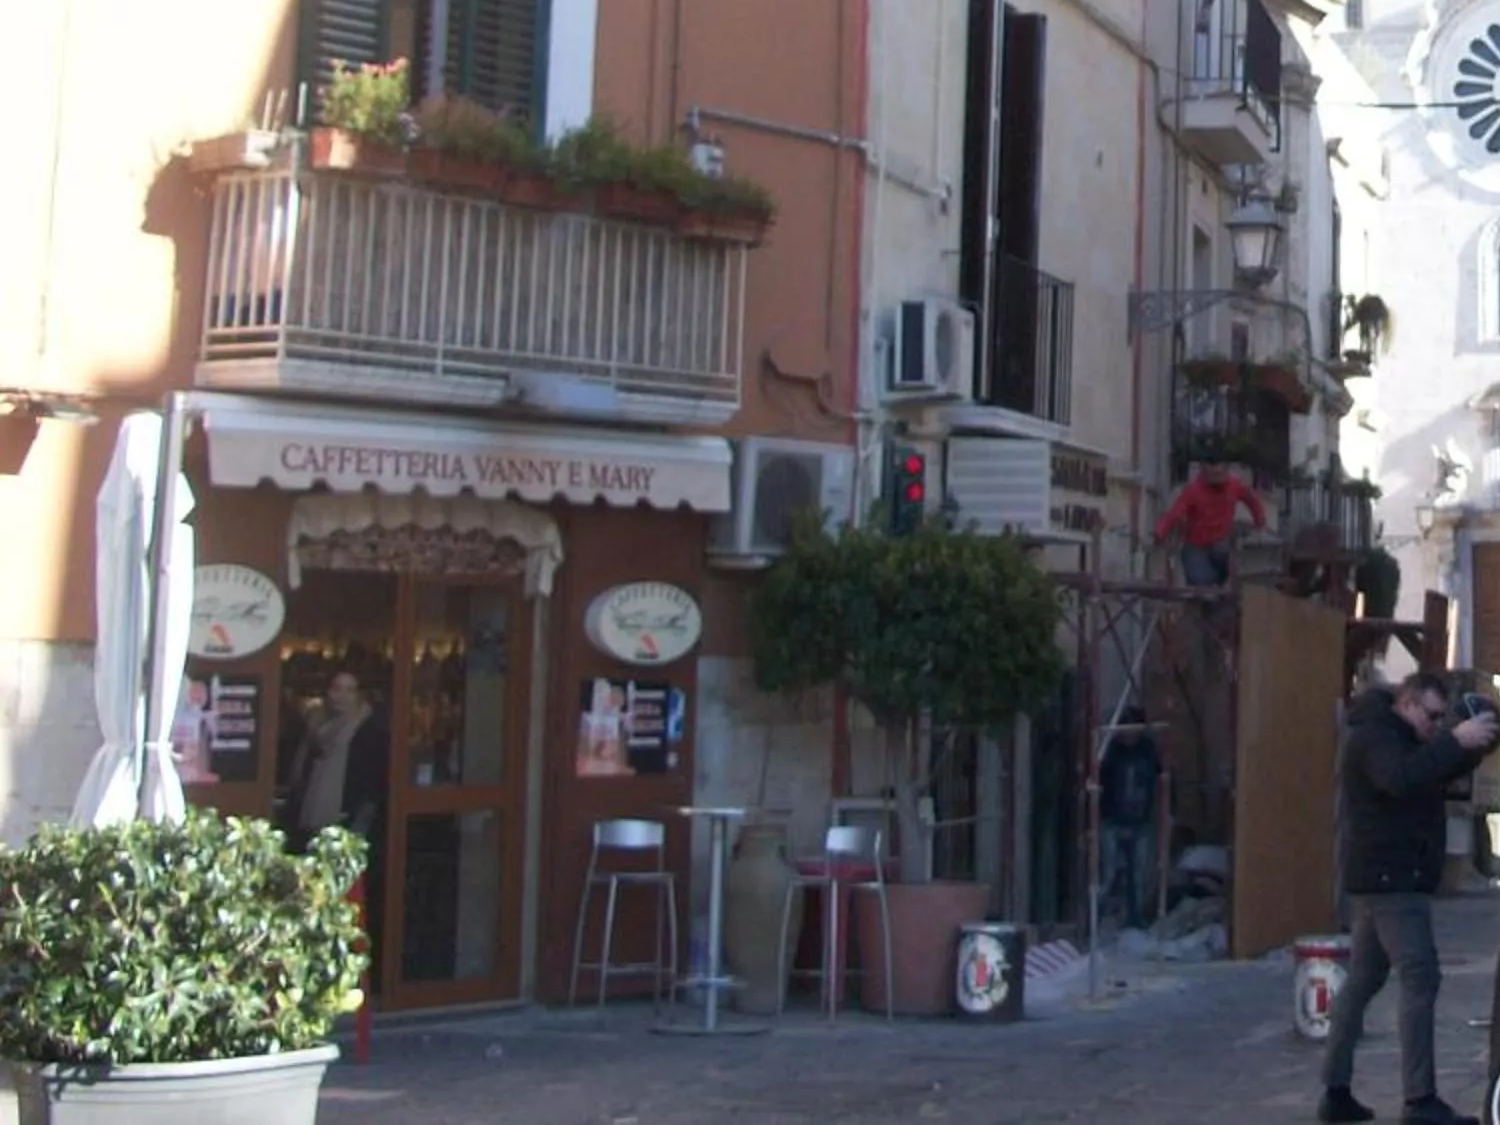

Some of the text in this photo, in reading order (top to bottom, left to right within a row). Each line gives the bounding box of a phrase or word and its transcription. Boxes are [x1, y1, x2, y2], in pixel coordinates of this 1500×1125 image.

[279, 442, 656, 492] CAFFETTERIA VANNY E MARY
